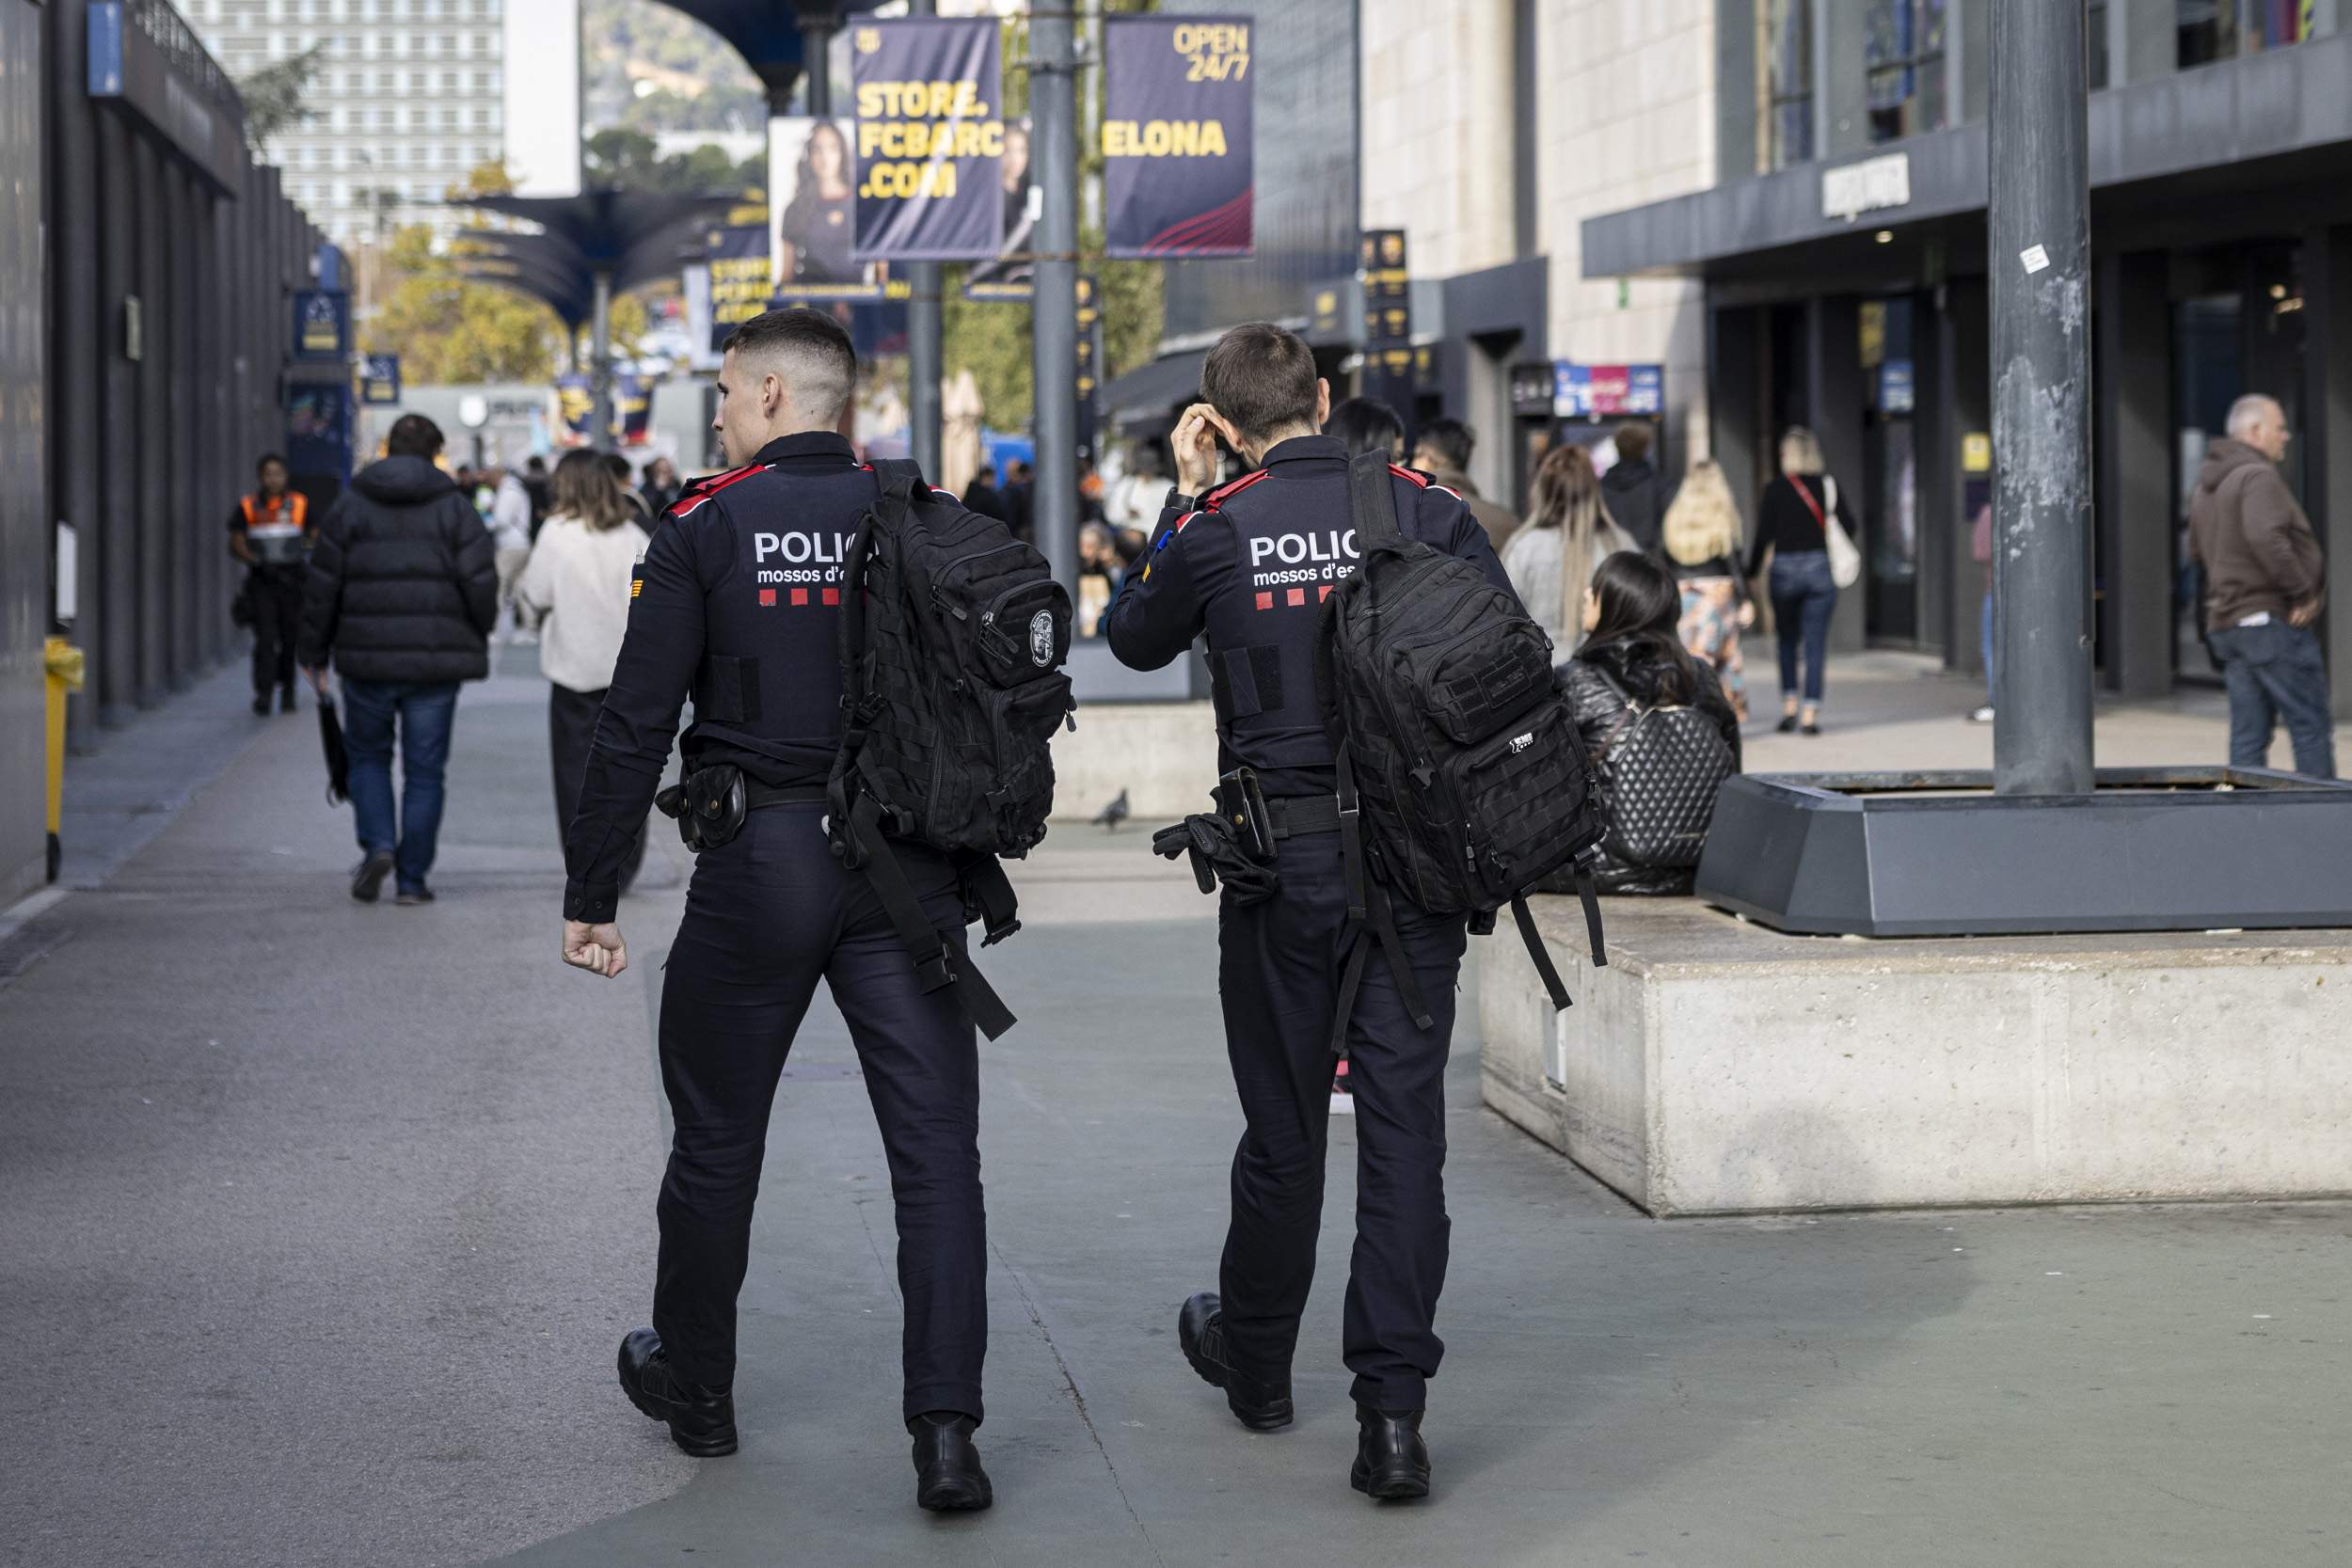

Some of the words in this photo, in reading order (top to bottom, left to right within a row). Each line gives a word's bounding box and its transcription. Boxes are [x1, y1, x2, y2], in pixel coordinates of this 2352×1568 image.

[1173, 24, 1248, 54] OPEN
[1186, 53, 1249, 82] 24/7
[857, 80, 989, 118] STORE.
[858, 120, 1005, 158] FCBARC
[1102, 119, 1227, 157] ELONA
[859, 161, 957, 198] .COM
[757, 569, 820, 583] mossos
[1253, 568, 1317, 586] mossos
